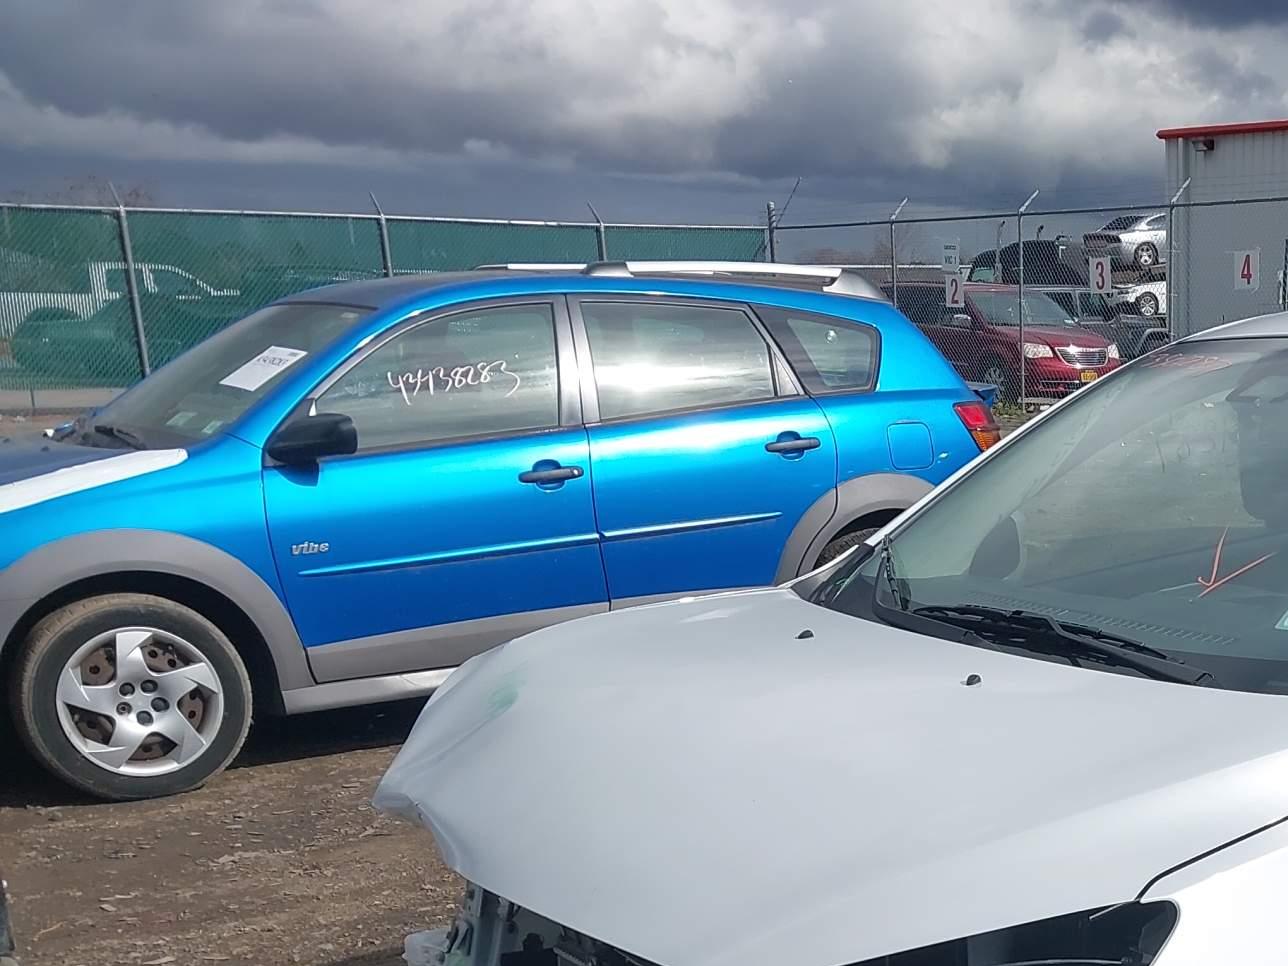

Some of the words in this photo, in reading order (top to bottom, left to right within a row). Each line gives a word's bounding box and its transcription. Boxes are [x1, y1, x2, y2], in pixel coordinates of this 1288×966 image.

[1095, 261, 1106, 291] 3
[1241, 254, 1252, 285] 4
[950, 278, 960, 304] 2
